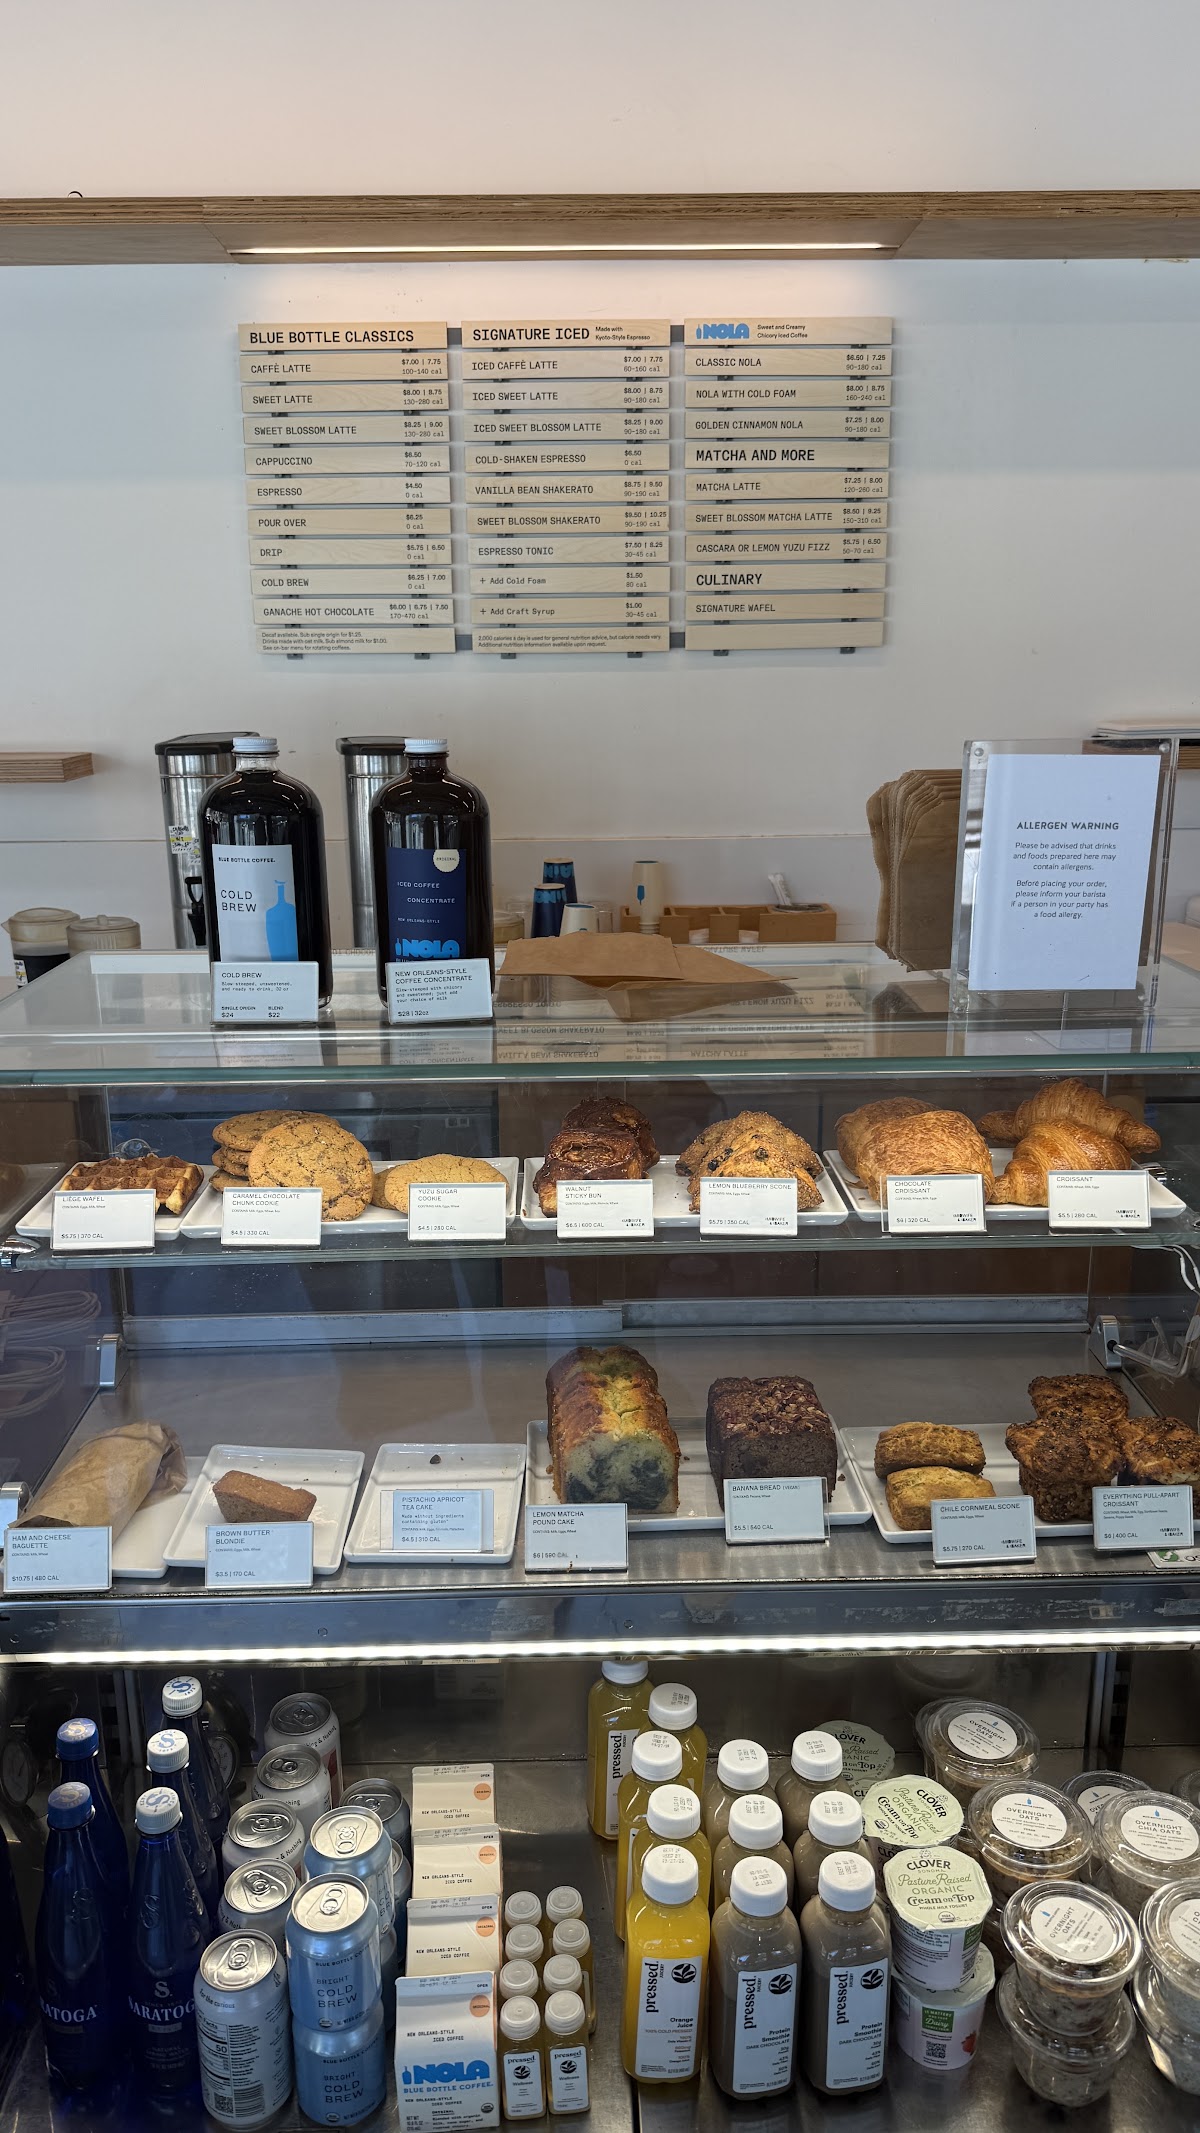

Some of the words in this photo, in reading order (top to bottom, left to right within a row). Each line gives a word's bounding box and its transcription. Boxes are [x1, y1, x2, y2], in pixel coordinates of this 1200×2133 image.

[250, 332, 284, 343] BLUE
[289, 332, 340, 343] BOTTLE
[345, 330, 414, 342] CLASSICS
[473, 329, 550, 341] SIGNATURE
[555, 328, 589, 339] ICED
[251, 363, 279, 373] CAFFÈ
[283, 364, 311, 373] LATTE
[695, 421, 729, 429] GOLDEN
[733, 421, 777, 429] CINNAMON
[780, 421, 803, 429] NOLA
[476, 456, 537, 464] COLD-SHAKEN
[541, 455, 585, 463] ESPRESSO
[696, 450, 746, 461] MATCHA
[752, 450, 776, 461] AND
[781, 449, 814, 461] MORE
[256, 457, 312, 465] CAPPUCCINO
[257, 488, 302, 496] ESPRESSO
[475, 486, 514, 494] VANILLA
[518, 486, 539, 494] BEAN
[543, 486, 593, 494] SHAKERATO
[697, 544, 735, 553] CASCARA
[738, 544, 749, 552] OR
[752, 544, 779, 552] LEMON
[782, 543, 804, 552] YUZU
[808, 543, 830, 551] FIZZ
[260, 549, 282, 557] DRIP
[696, 574, 762, 586] CULINARY
[264, 608, 302, 616] GANACHE
[696, 604, 745, 613] SIGNATURE
[748, 604, 775, 612] WAFEL
[1017, 822, 1067, 830] ALLERGEN
[1071, 822, 1119, 830] WARNING
[1050, 853, 1081, 861] prepared
[221, 890, 252, 900] COLD
[222, 903, 256, 912] BREW
[1058, 911, 1082, 919] allergy.
[402, 940, 459, 958] NOLA
[413, 968, 467, 976] ORLEANS-STYLE
[1006, 1807, 1052, 1818] OVERNIGHT
[1135, 1820, 1183, 1831] OVERNIGHT
[907, 1860, 950, 1870] CLOVER
[898, 1874, 936, 1886] Pasture
[936, 1873, 971, 1885] Raised
[912, 1885, 964, 1894] ORGANIC
[908, 1896, 942, 1906] Cream
[953, 1894, 974, 1903] Top
[317, 1976, 349, 1984] BRIGHT
[318, 1985, 353, 1997] COLD
[318, 1993, 357, 2008] BREW
[769, 2027, 790, 2035] Protein
[762, 2033, 790, 2042] Smoothie
[761, 2039, 790, 2048] CHOCOLATE
[413, 2060, 490, 2084] NOLA
